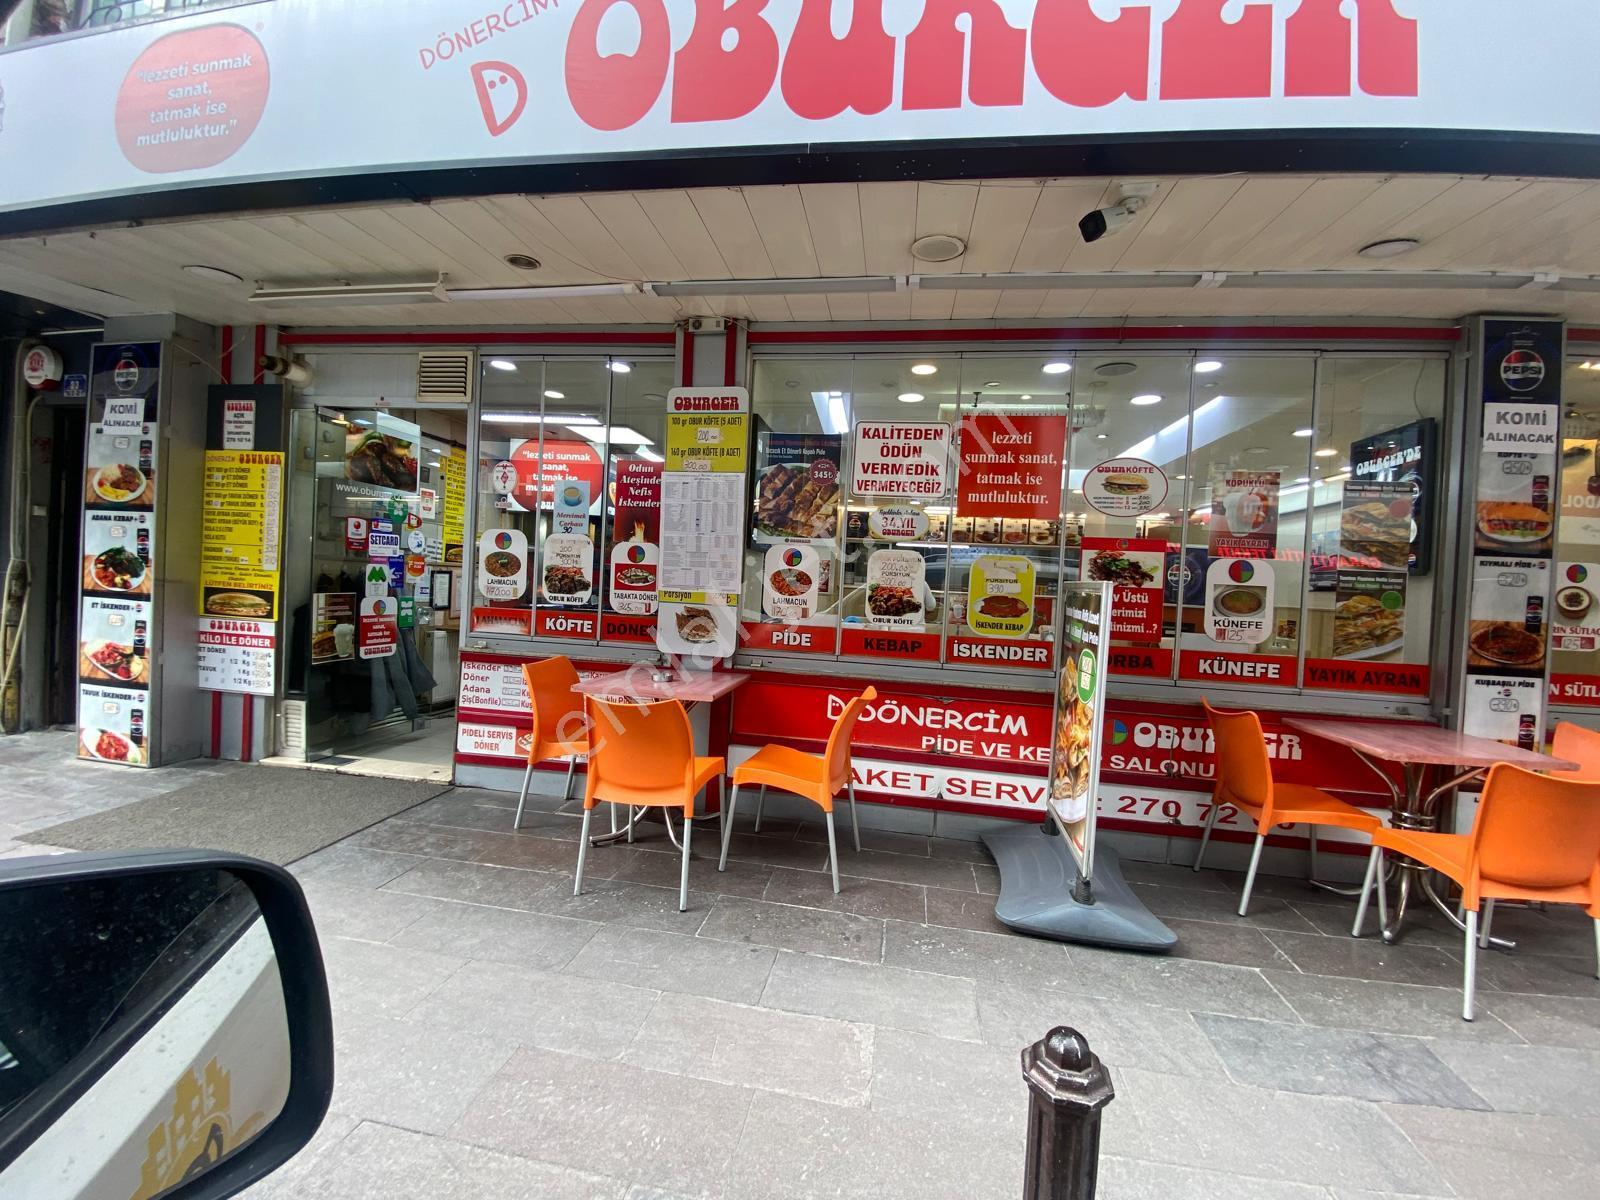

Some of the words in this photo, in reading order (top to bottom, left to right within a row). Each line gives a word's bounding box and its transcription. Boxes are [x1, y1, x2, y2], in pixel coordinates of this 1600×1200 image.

[191, 53, 253, 75] sunmak
[565, 0, 1418, 131] OBURGER
[167, 81, 213, 101] sanat,
[149, 104, 201, 125] tatmak
[205, 100, 227, 115] ise
[1503, 365, 1542, 375] PEPSI
[109, 402, 138, 415] KOMİ
[673, 396, 740, 411] OBURGER
[103, 419, 142, 428] ALINACAK
[681, 419, 687, 427] gr
[688, 417, 703, 426] OBUR
[703, 415, 720, 426] KÖFTE
[727, 417, 742, 426] ADET)
[1495, 409, 1547, 426] KOMİ
[862, 424, 943, 441] KALİTEDEN
[992, 431, 1033, 445] lezzeti
[1486, 432, 1554, 444] ALINACAK
[556, 452, 591, 461] sunmak
[670, 448, 680, 456] 160
[680, 449, 686, 458] gr
[687, 447, 702, 457] OBUR
[702, 445, 718, 457] KÖFTE
[726, 448, 741, 457] ADET)
[880, 443, 922, 459] ÖDÜN
[964, 452, 1015, 465] sunmak
[1018, 452, 1058, 466] sanat,
[541, 463, 570, 473] sanat,
[628, 464, 654, 474] Odun
[861, 461, 940, 477] VERMEDİK
[620, 474, 662, 486] Ateşinde
[856, 477, 942, 494] VERMEYECEĞİZ
[976, 472, 1021, 485] tatmak
[1025, 472, 1043, 485] ise
[628, 486, 653, 497] Nefis
[967, 490, 1050, 505] mutluluktur.
[618, 495, 661, 508] İskender
[370, 535, 399, 547] SETCARD
[1479, 560, 1513, 568] KIYMALI
[486, 578, 518, 586] LAHMACUN
[613, 592, 638, 601] TABAKTA
[638, 591, 658, 601] DÖNER
[772, 597, 808, 606] LAHMACUN
[1122, 589, 1149, 604] Üstü
[545, 616, 593, 633] KÖFTE
[872, 616, 892, 625] OBUR
[892, 617, 914, 626] KÖFTE
[975, 619, 1004, 631] İSKENDER
[1004, 621, 1024, 632] KEBAP
[1213, 617, 1263, 630] KÜNEFE
[606, 620, 657, 637] DÖNE
[200, 632, 221, 643] KİLO
[222, 633, 237, 645] İLE
[239, 636, 271, 647] DÖNER
[772, 629, 812, 647] PİDE
[863, 637, 922, 653] KEBAP
[952, 639, 1048, 663] İSKENDER
[1198, 656, 1281, 680] KÜNEFE
[463, 672, 490, 682] Döner
[1308, 667, 1358, 684] YAYIK
[1361, 670, 1420, 689] AYRAN
[462, 684, 491, 694] Adana
[857, 699, 1029, 737] DÖNERCİM
[474, 740, 500, 751] DÖNER
[921, 734, 974, 756] PİDE
[980, 741, 1011, 758] VE
[1109, 754, 1215, 778] SALONU
[850, 768, 935, 792] AKET
[1117, 795, 1182, 818] 270
